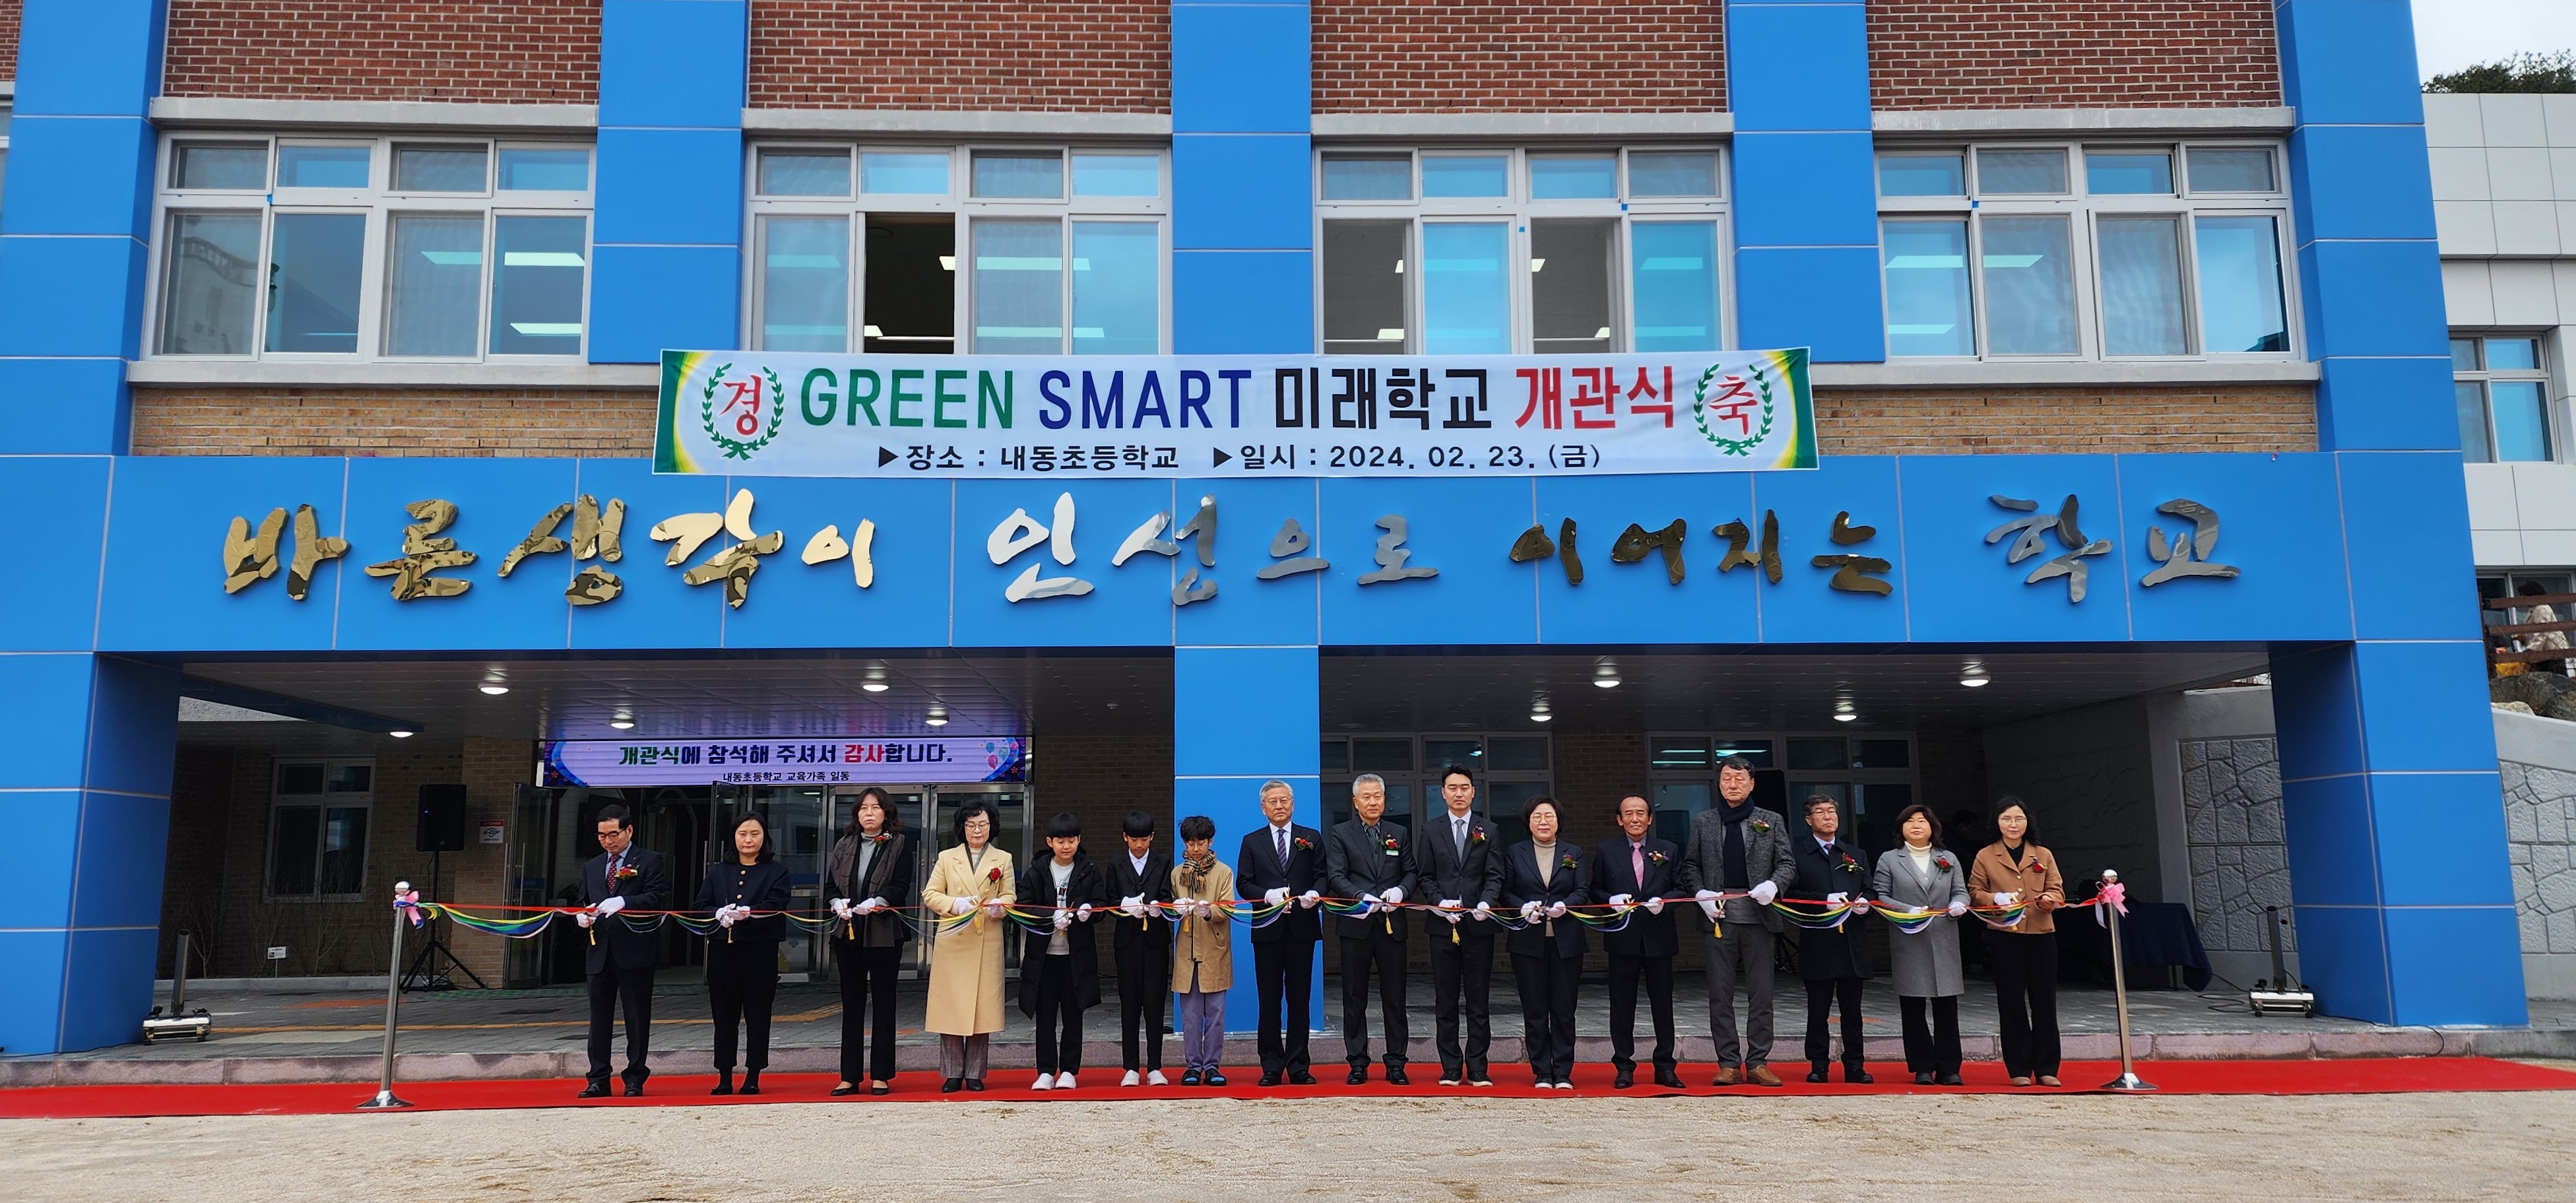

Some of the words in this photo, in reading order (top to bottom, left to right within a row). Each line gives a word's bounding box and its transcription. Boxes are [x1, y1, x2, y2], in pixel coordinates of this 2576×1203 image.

[724, 374, 761, 436] 경
[800, 368, 1014, 429] GREEN
[1039, 370, 1252, 430] SMART
[1275, 367, 1493, 430] 미래학교
[1515, 366, 1674, 430] 개관식
[1709, 375, 1758, 436] 축
[906, 445, 965, 471] 장소
[1000, 445, 1178, 471] 내동초등학교
[1240, 444, 1295, 470] 일시
[1330, 445, 1415, 469] 2024.
[1428, 445, 1475, 469] 02.
[1489, 445, 1535, 469] 23.
[1549, 444, 1600, 469] (금)
[1509, 509, 1894, 599] 이어지는
[1985, 494, 2241, 603] 학교
[619, 746, 701, 765] 개관식에
[708, 744, 769, 764] 참석해
[776, 744, 837, 764] 주셔서
[845, 743, 952, 763] 감사합니다.
[723, 771, 783, 783] 내동초등학교
[786, 771, 826, 782] 교육가족
[830, 771, 850, 781] 일동
